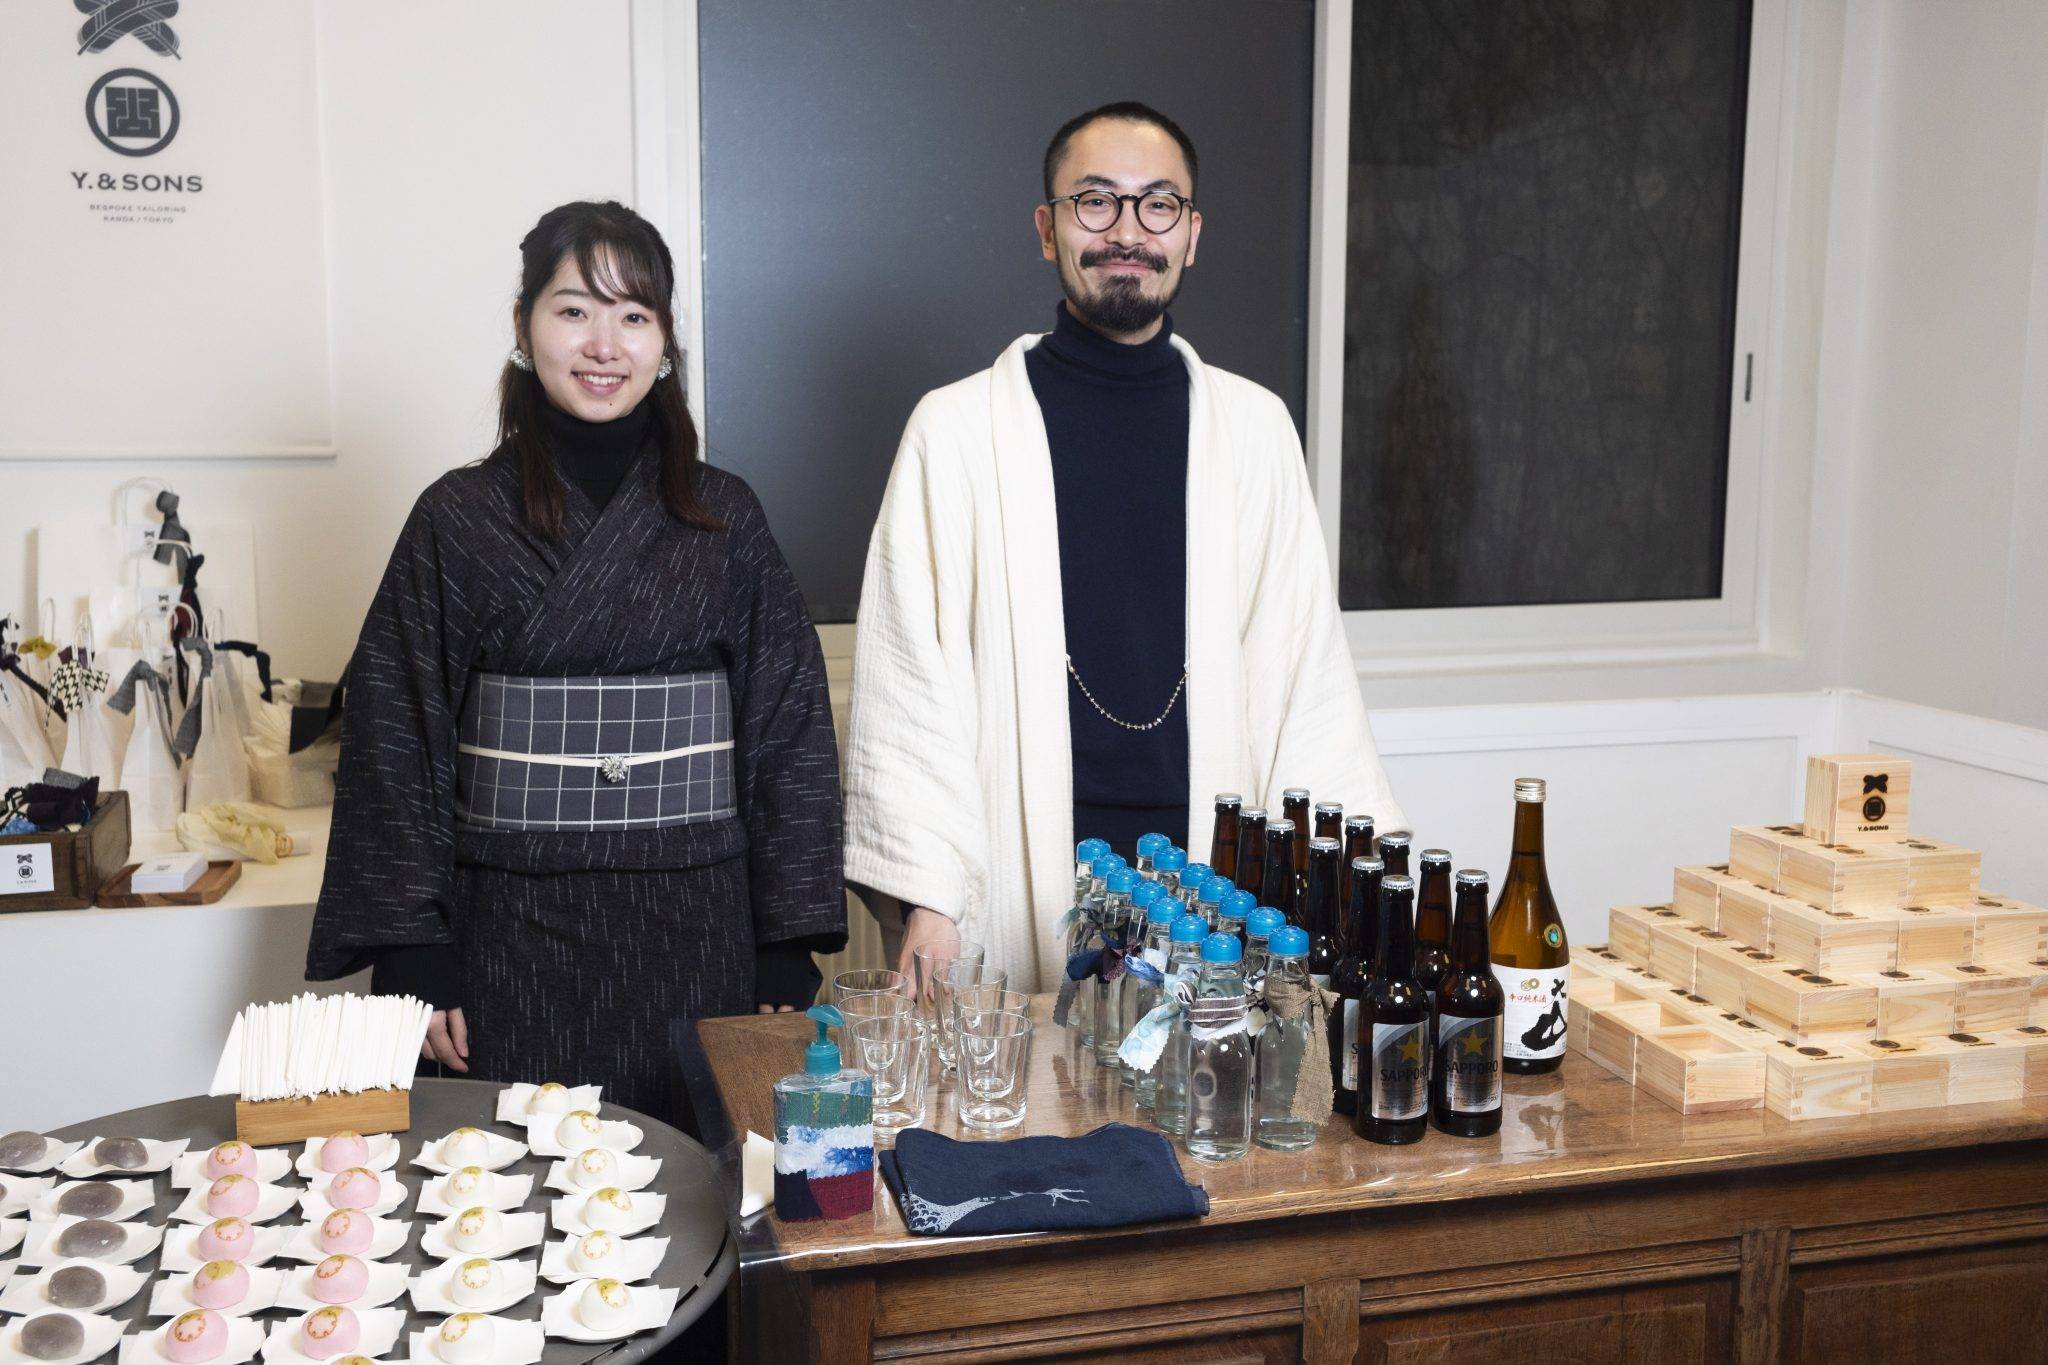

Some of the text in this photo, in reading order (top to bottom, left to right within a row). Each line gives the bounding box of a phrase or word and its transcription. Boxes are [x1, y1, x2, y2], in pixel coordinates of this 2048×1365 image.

[90, 204, 187, 213] BESPOKE TAILORING
[1445, 1060, 1499, 1075] SAPPORO
